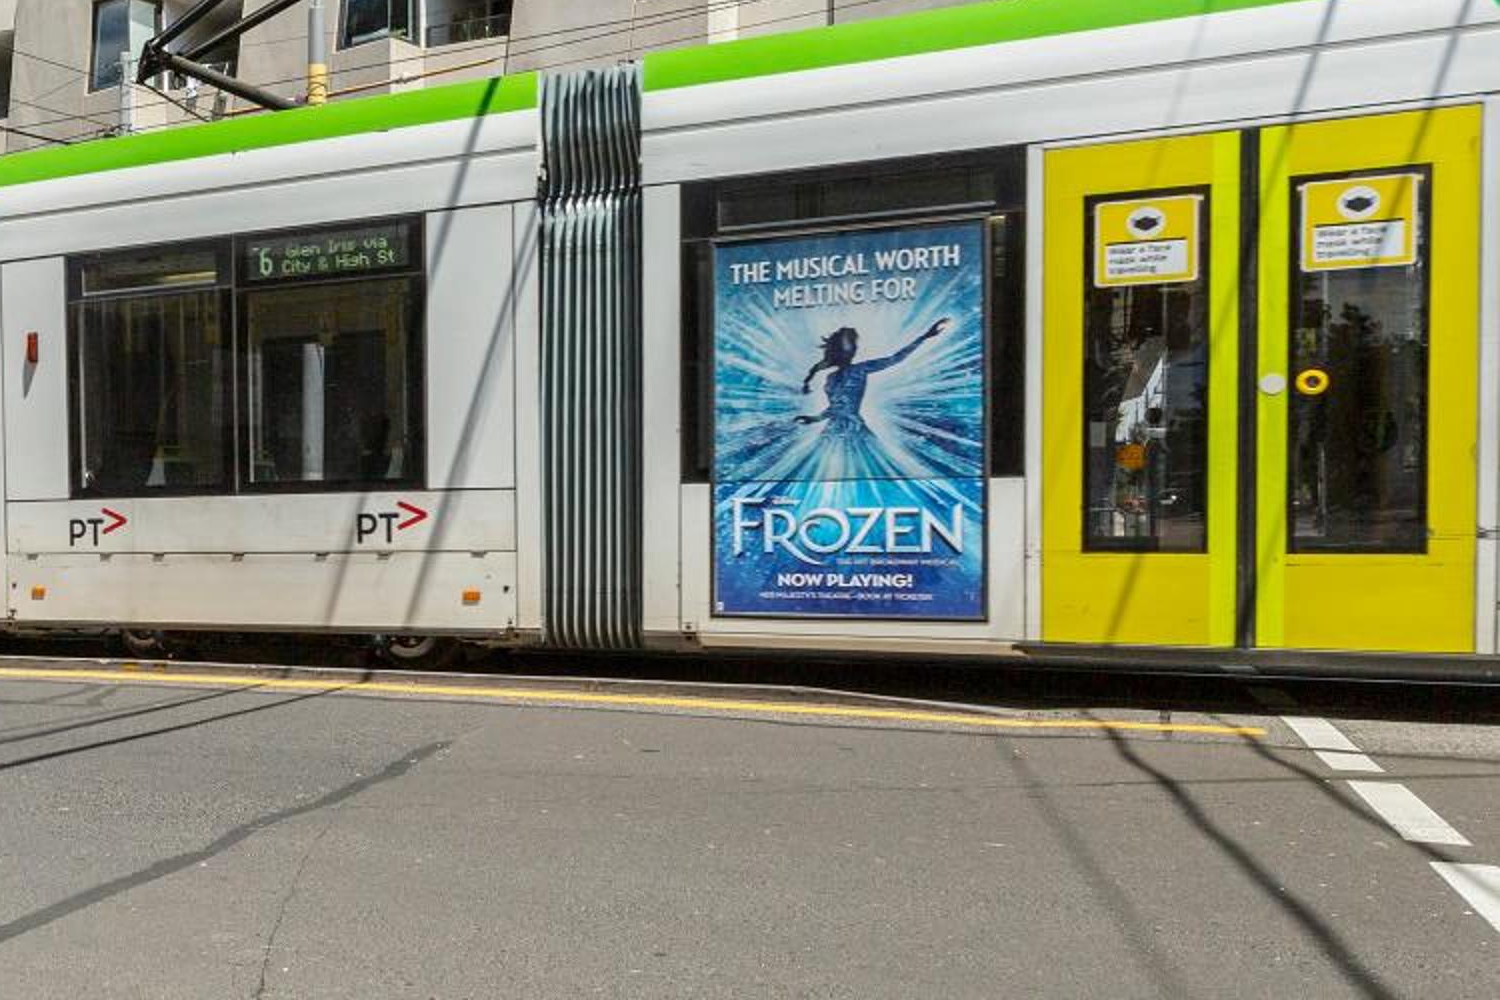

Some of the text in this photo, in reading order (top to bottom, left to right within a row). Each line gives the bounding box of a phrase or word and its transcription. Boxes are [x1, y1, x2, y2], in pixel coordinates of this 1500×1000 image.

[285, 233, 389, 258] Glen Iris via
[259, 247, 273, 276] 6
[281, 258, 311, 274] City
[335, 252, 370, 268] High
[376, 249, 396, 265] St
[730, 244, 962, 285] THE MUSICAL WORTH
[773, 277, 917, 308] MELTING FOR
[731, 496, 965, 566] FROZEN
[777, 573, 914, 588] NOW PLAYING!
